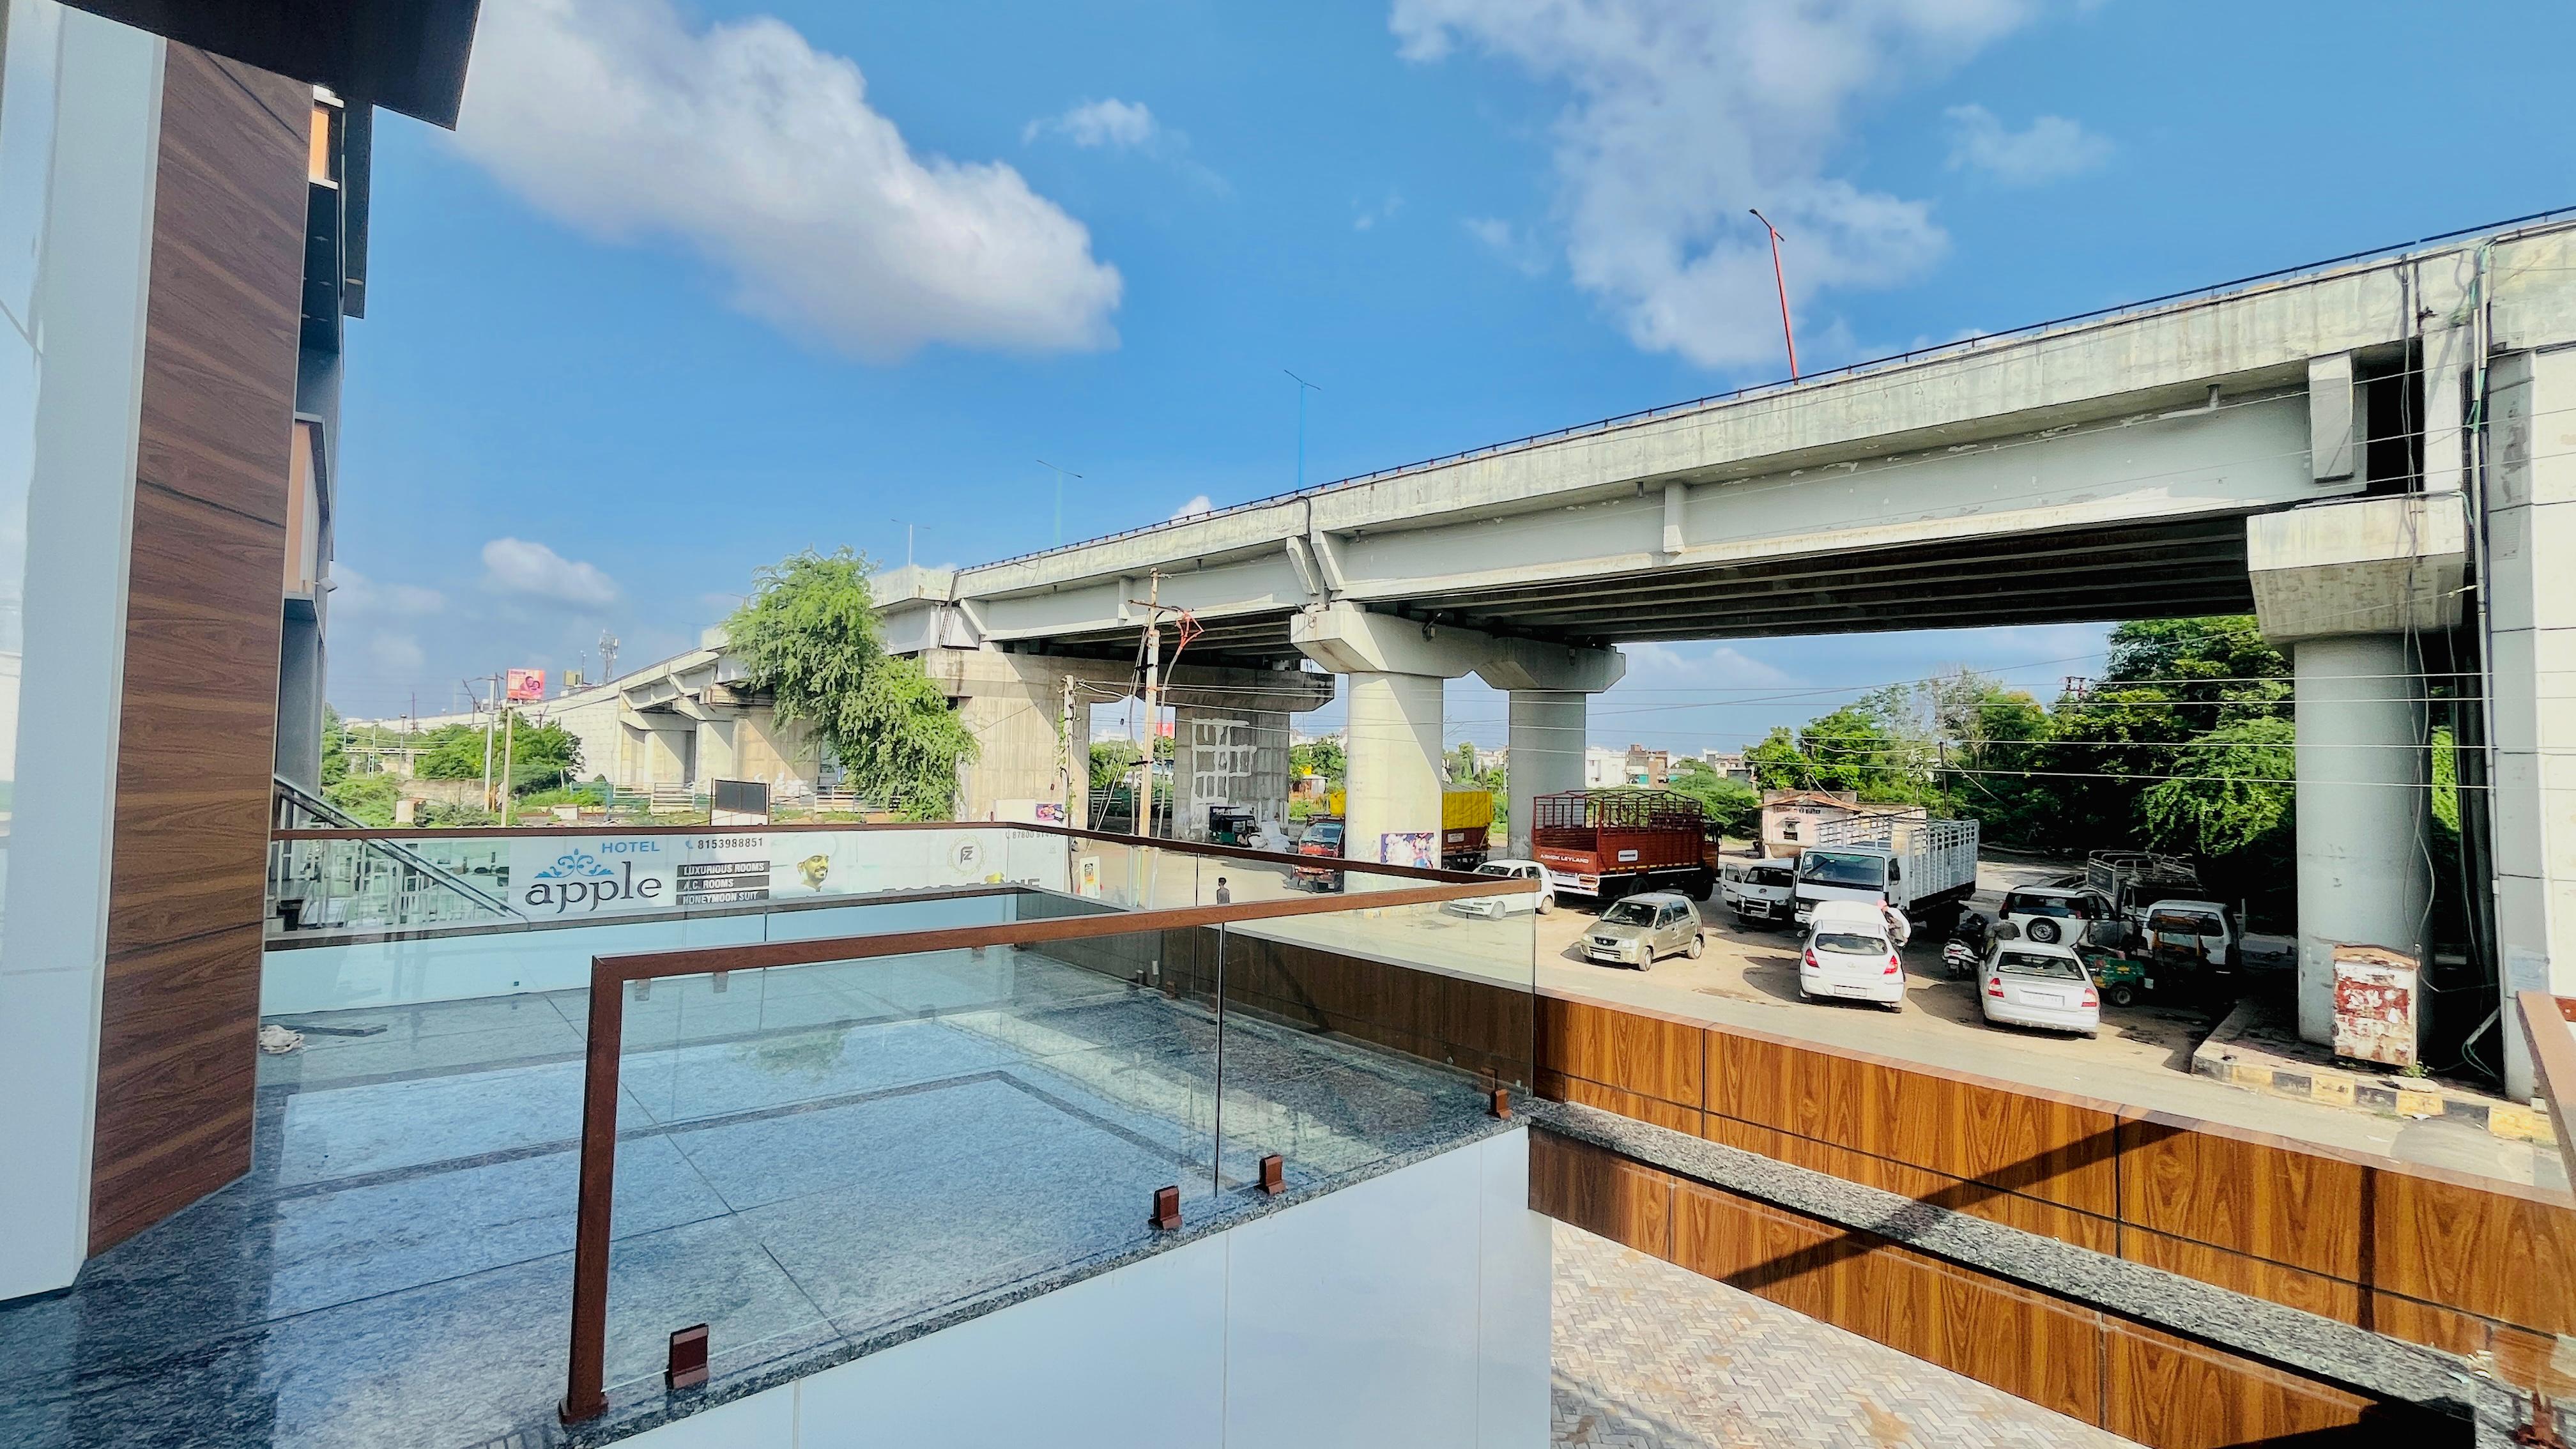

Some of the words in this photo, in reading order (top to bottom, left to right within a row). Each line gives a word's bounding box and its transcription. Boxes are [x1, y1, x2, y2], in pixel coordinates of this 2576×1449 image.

[601, 841, 660, 854] HOTEL
[698, 837, 763, 849] 8153988851
[683, 864, 733, 876] LUXURIOUS
[734, 862, 765, 873] ROOMS
[525, 861, 662, 914] apple
[702, 878, 734, 889] ROOMS
[682, 894, 737, 905] HONEYMOON
[738, 891, 758, 901] SUIT
